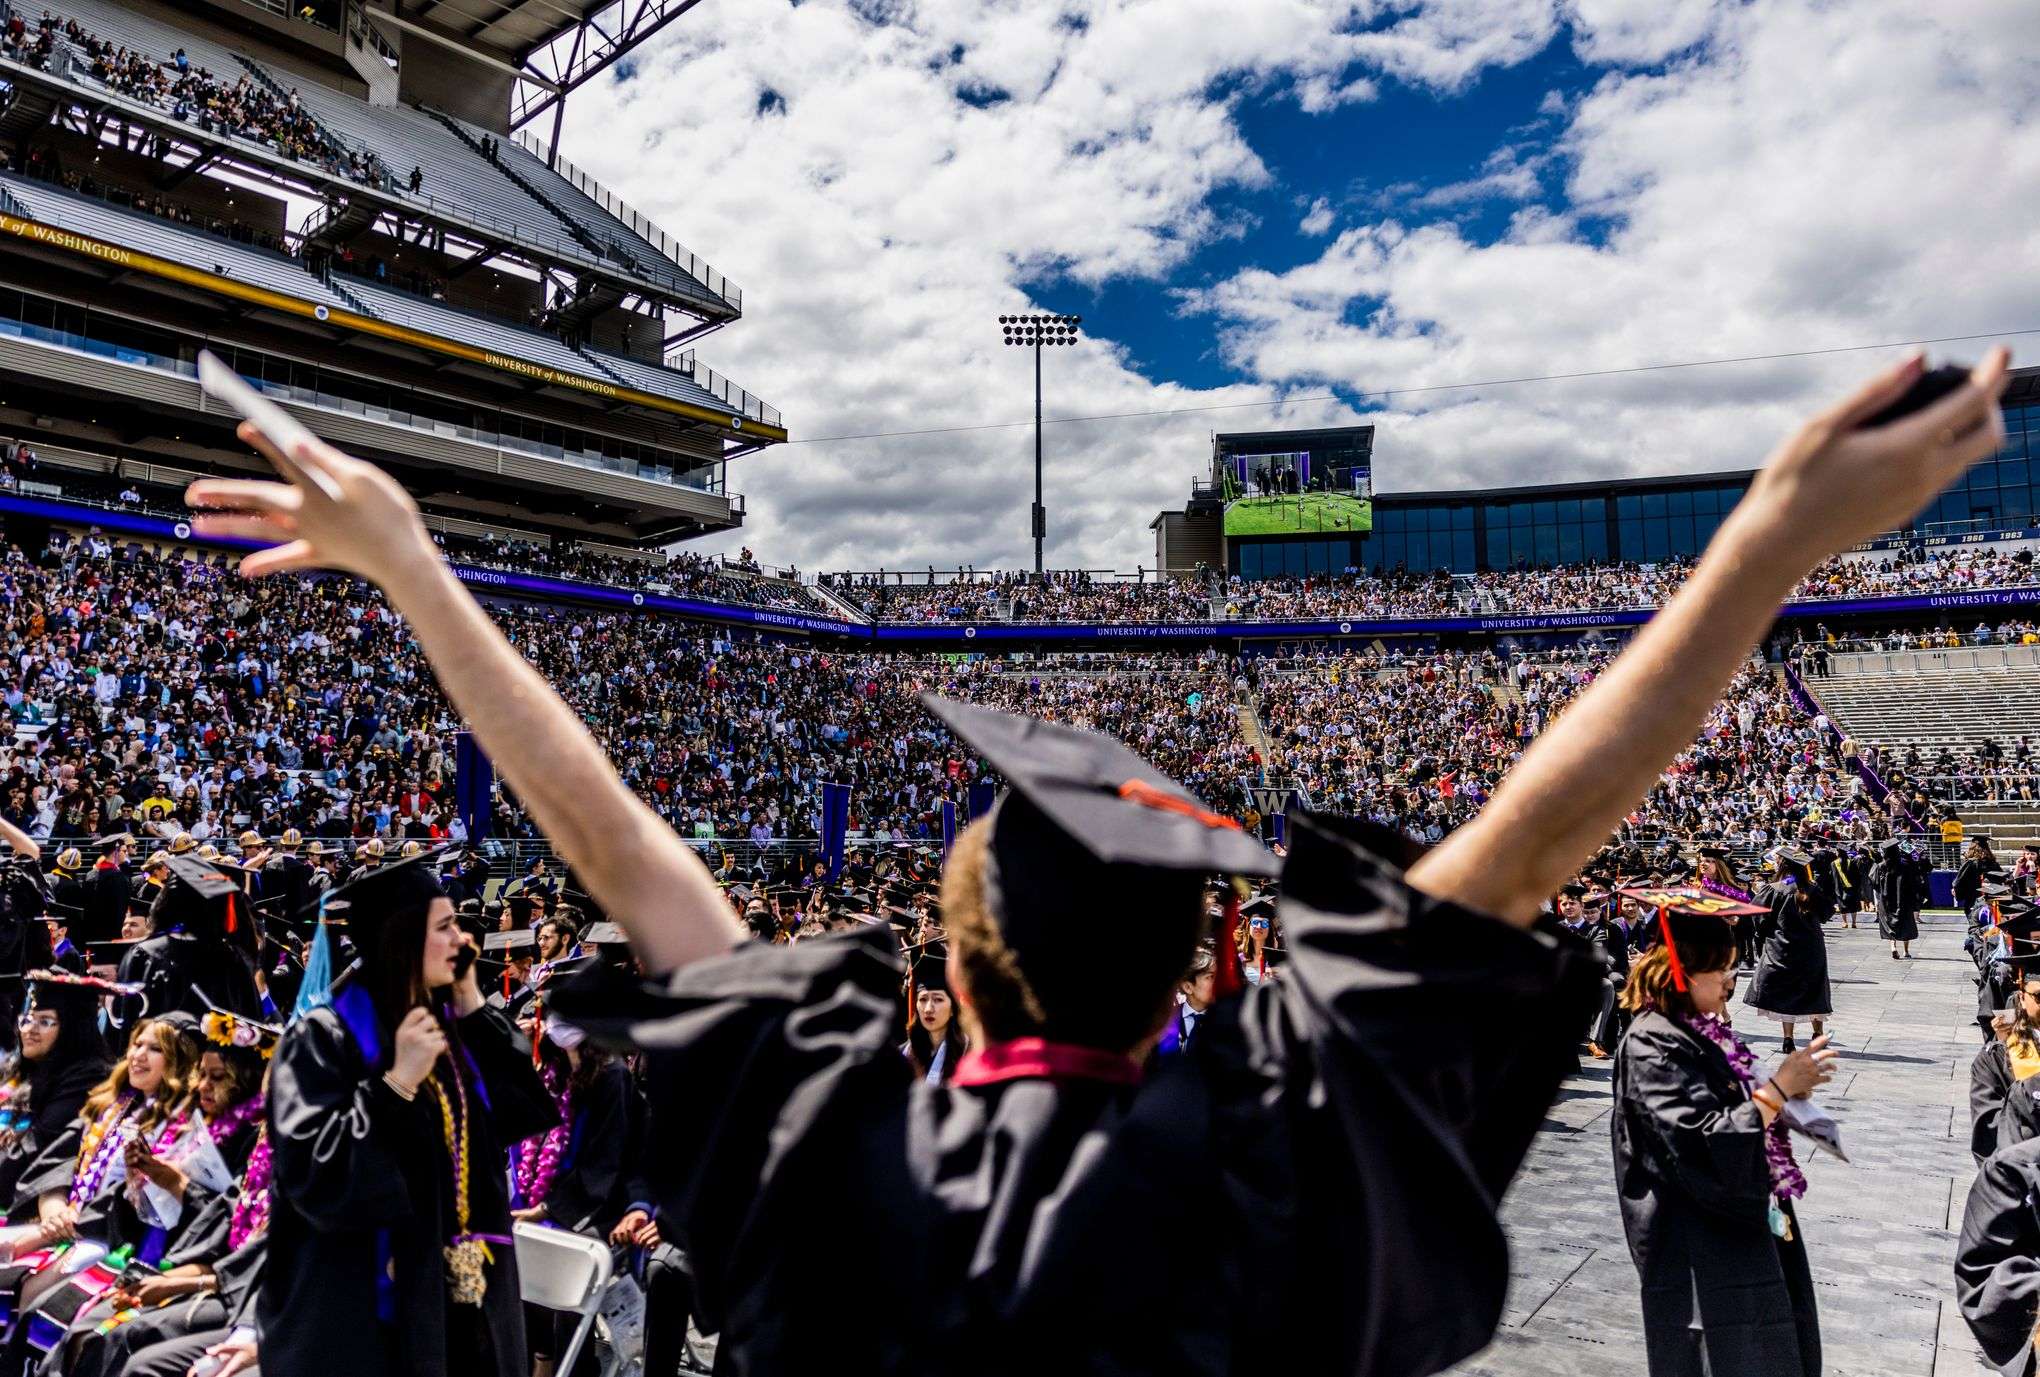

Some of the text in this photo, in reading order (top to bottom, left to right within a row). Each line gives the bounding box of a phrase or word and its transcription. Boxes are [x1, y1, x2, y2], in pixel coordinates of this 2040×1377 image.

[12, 222, 28, 236] of
[32, 225, 130, 263] WASHINGTON
[485, 353, 616, 395] UNIVERSITY of WASHINGTON
[1924, 538, 1947, 546] 1959
[1961, 535, 1984, 543] 1960
[1999, 531, 2023, 540] 1963
[1930, 593, 1999, 606] UNIVERSITY
[2003, 592, 2014, 604] of
[754, 611, 850, 633] UNIVERSITY of WASHINGTON
[1481, 615, 1616, 629] UNIVERSITY of WASHINGTON
[1097, 627, 1217, 637] UNIVERSITY of WASHINGTON
[1253, 791, 1290, 816] W
